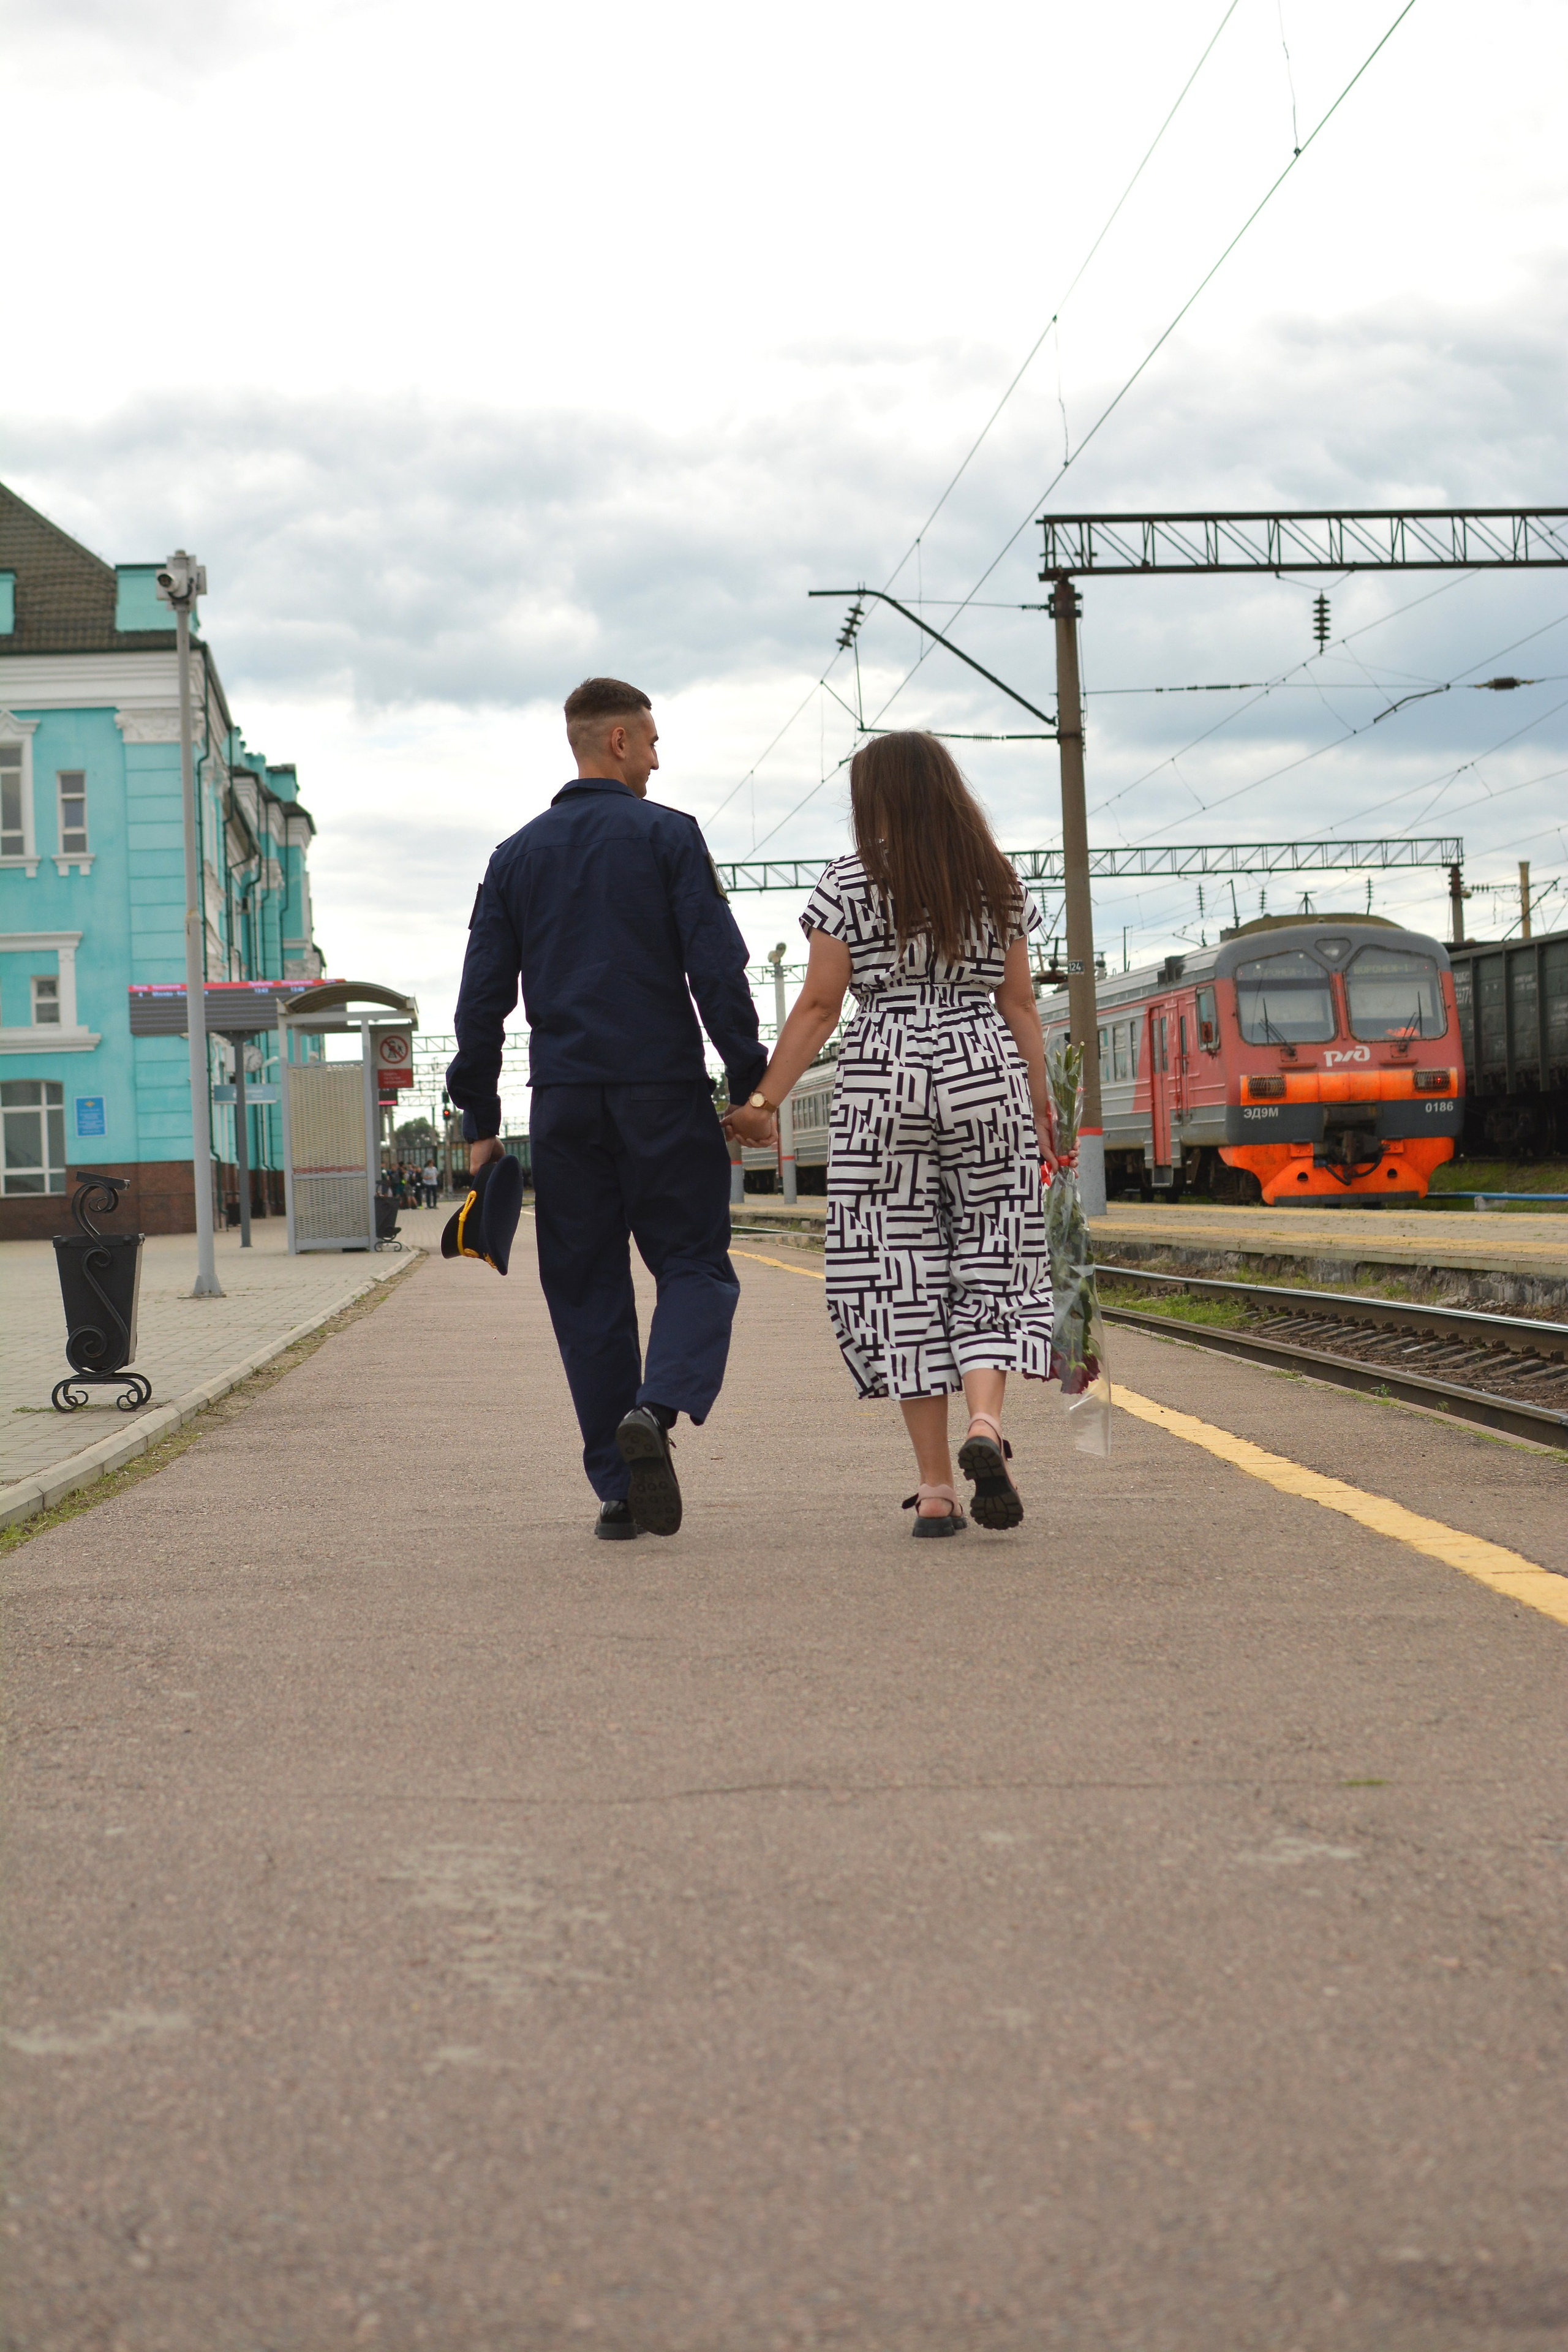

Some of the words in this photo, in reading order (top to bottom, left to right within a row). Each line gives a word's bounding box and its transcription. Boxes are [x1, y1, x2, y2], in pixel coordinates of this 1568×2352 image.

[1069, 962, 1081, 971] 124
[1425, 1101, 1453, 1113] 0186
[1243, 1107, 1279, 1120] ЭД9М
